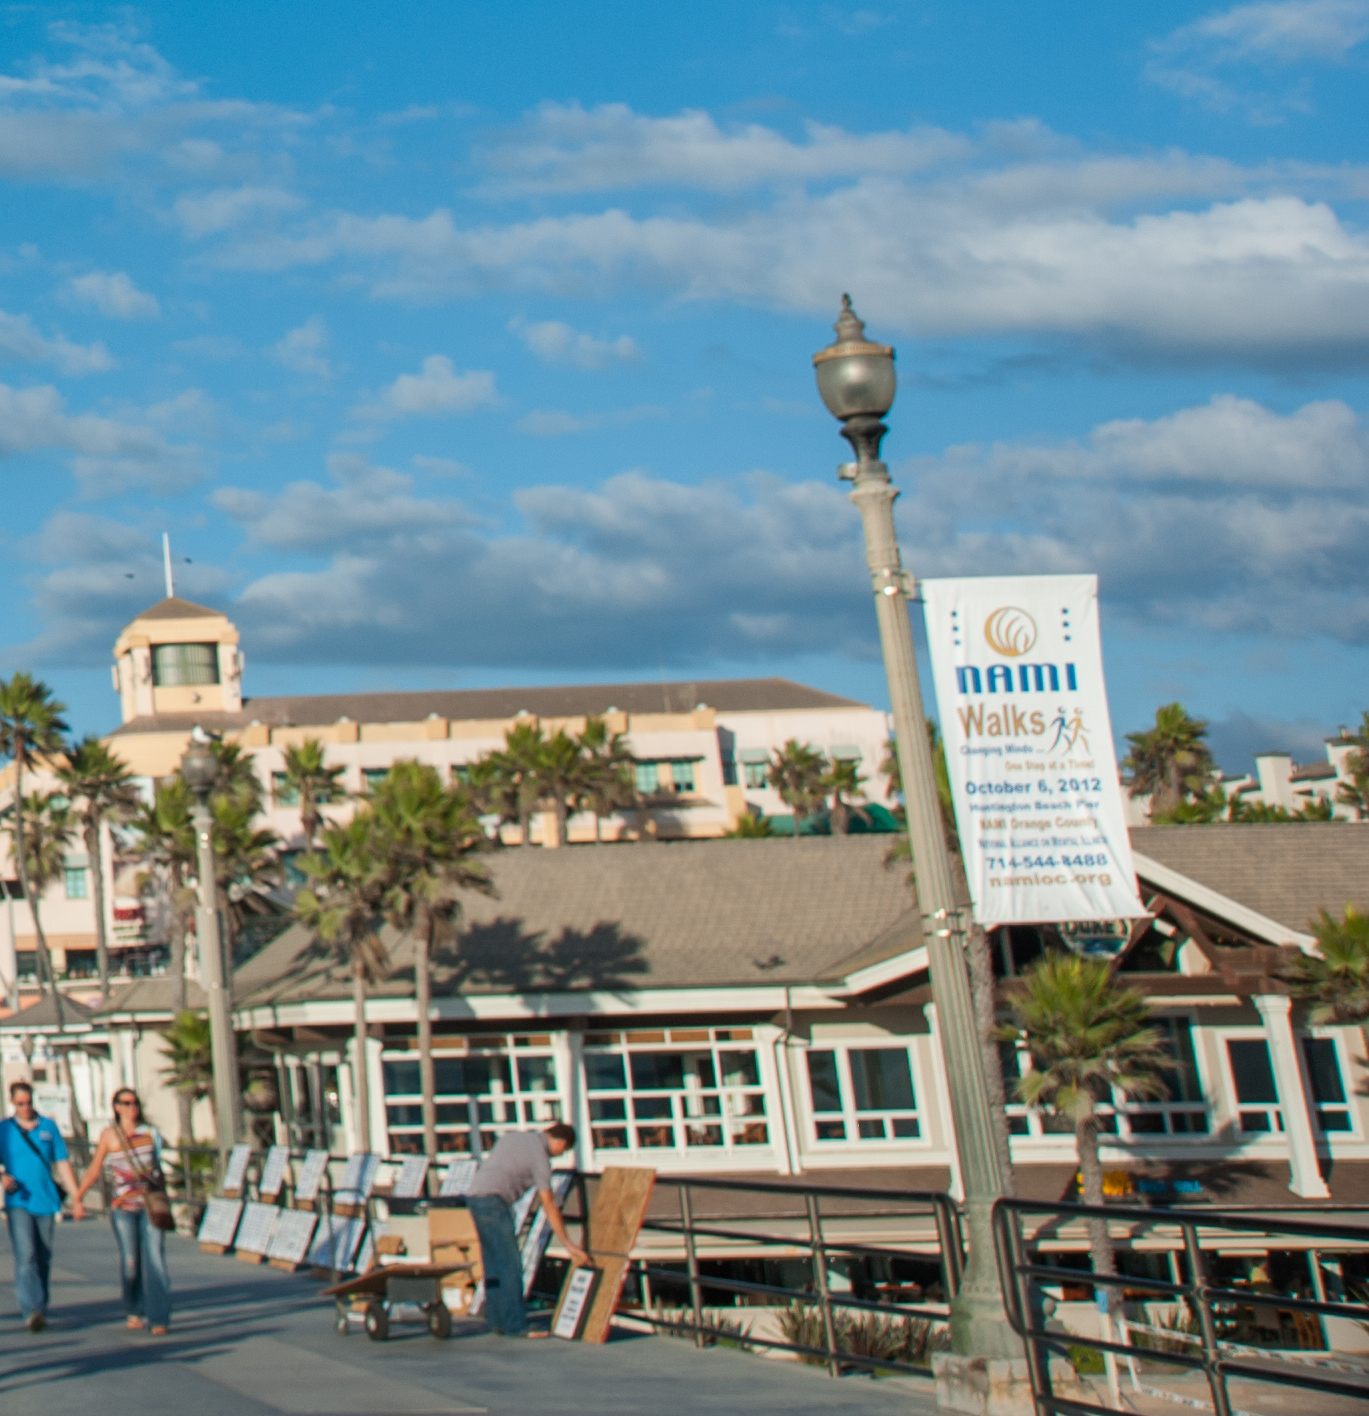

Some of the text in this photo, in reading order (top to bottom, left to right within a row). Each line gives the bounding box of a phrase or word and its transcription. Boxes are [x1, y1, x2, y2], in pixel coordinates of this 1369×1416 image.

[956, 703, 1046, 739] Walks
[965, 777, 1102, 796] October 6, 2012
[985, 853, 1109, 870] 714-544-8488
